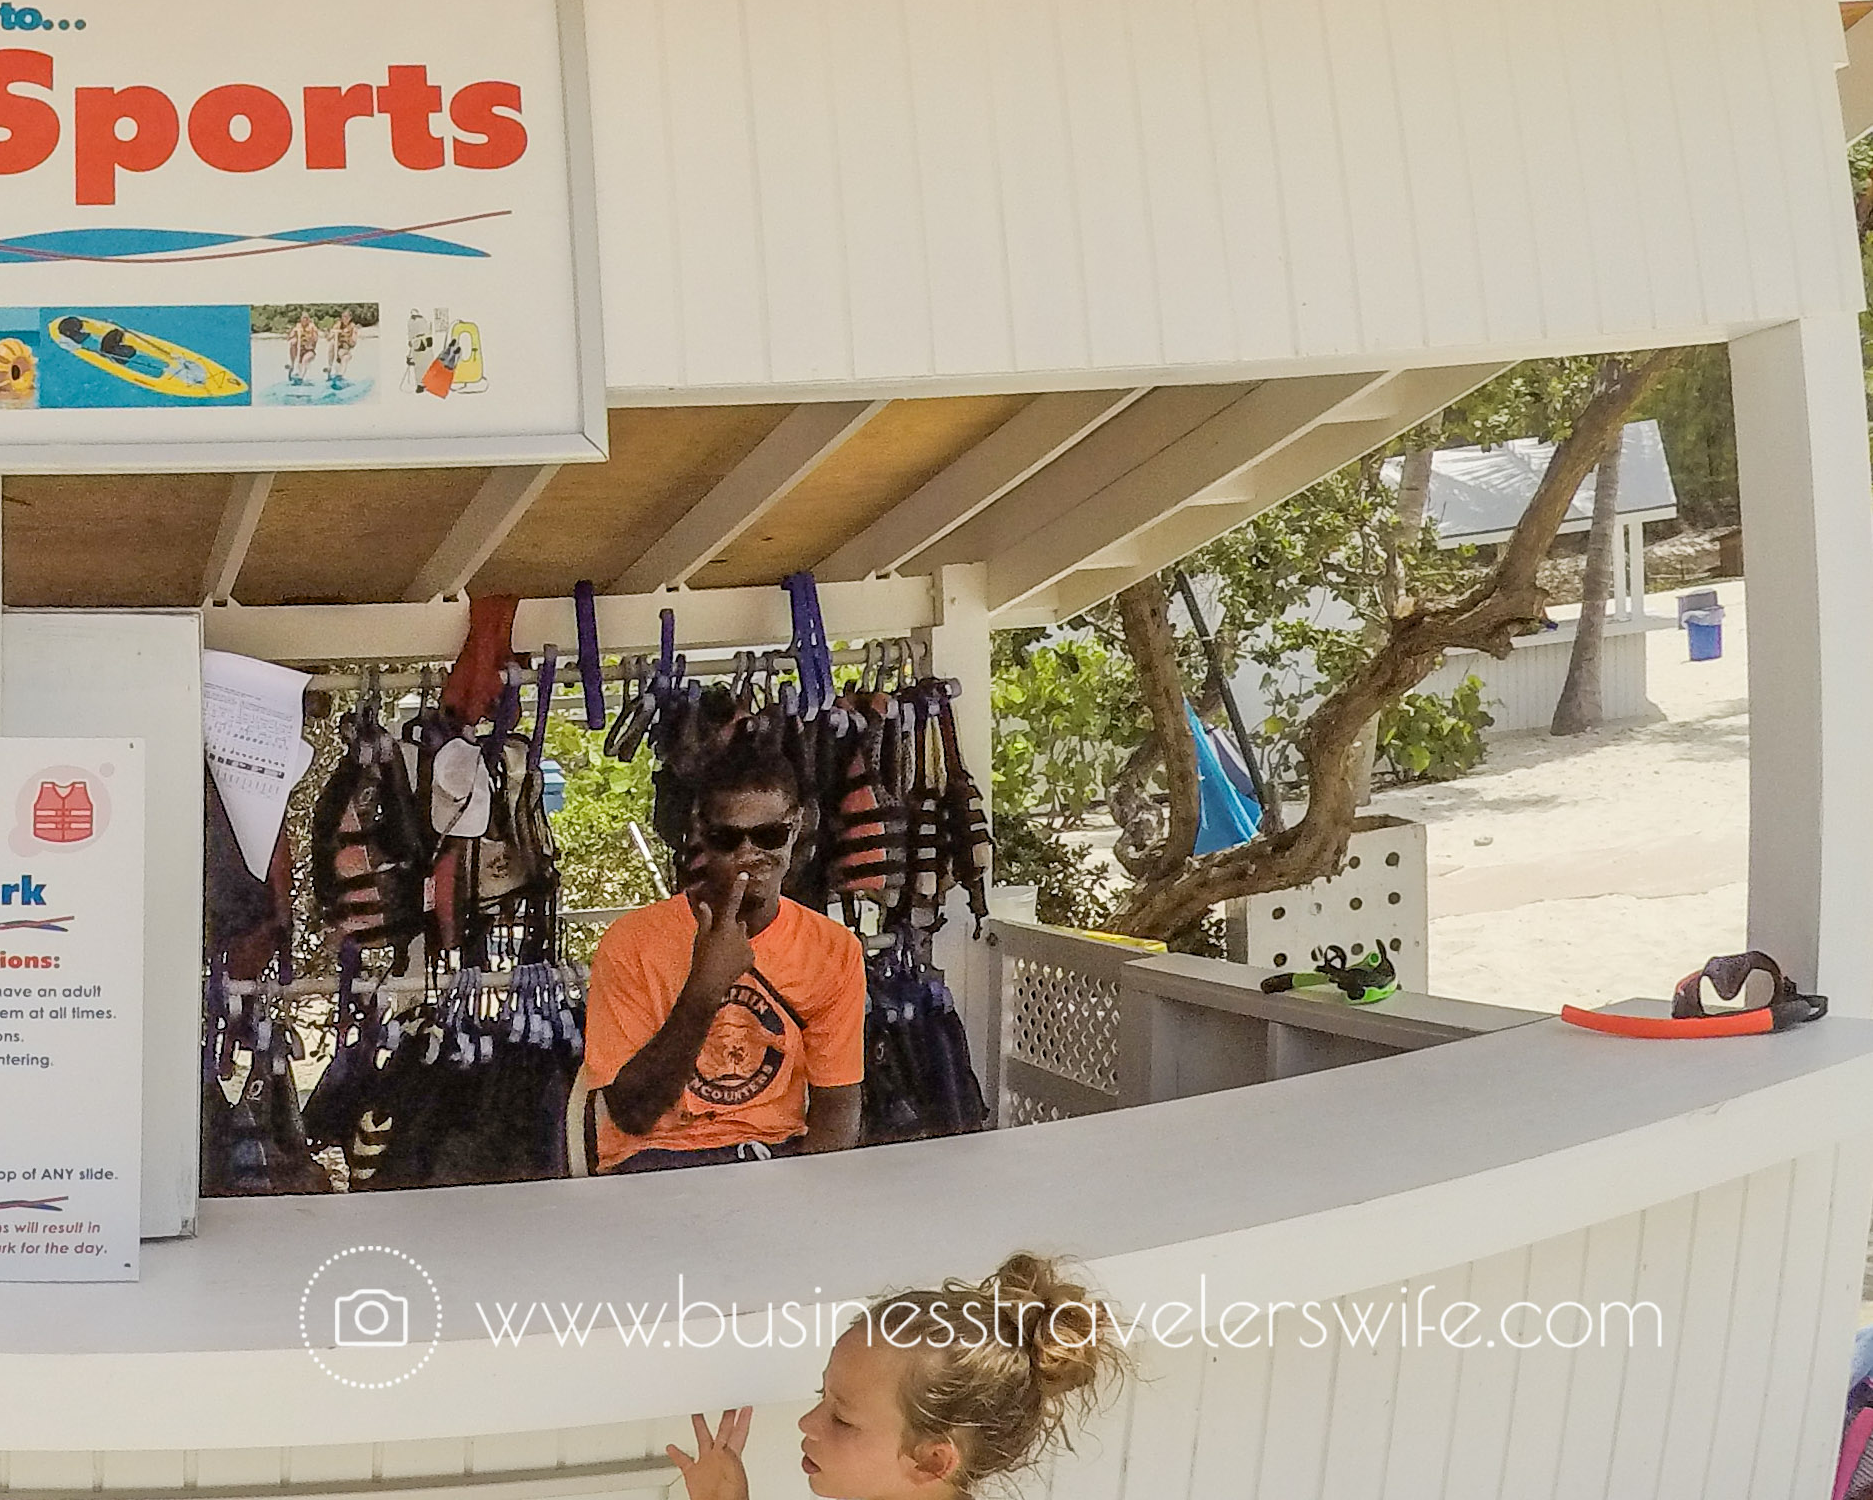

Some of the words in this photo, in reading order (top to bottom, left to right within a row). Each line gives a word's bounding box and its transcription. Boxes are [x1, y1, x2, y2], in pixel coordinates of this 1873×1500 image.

[37, 988, 57, 998] an
[61, 984, 102, 998] adult
[28, 1006, 45, 1020] at
[48, 1006, 67, 1020] all
[71, 1006, 117, 1020] times.
[21, 1167, 37, 1181] of
[40, 1168, 74, 1181] ANY
[78, 1167, 119, 1181] slide.
[14, 1221, 39, 1234] will
[42, 1221, 84, 1234] result
[87, 1220, 101, 1234] in
[20, 1241, 41, 1255] for
[44, 1241, 70, 1255] the
[73, 1241, 108, 1257] day.
